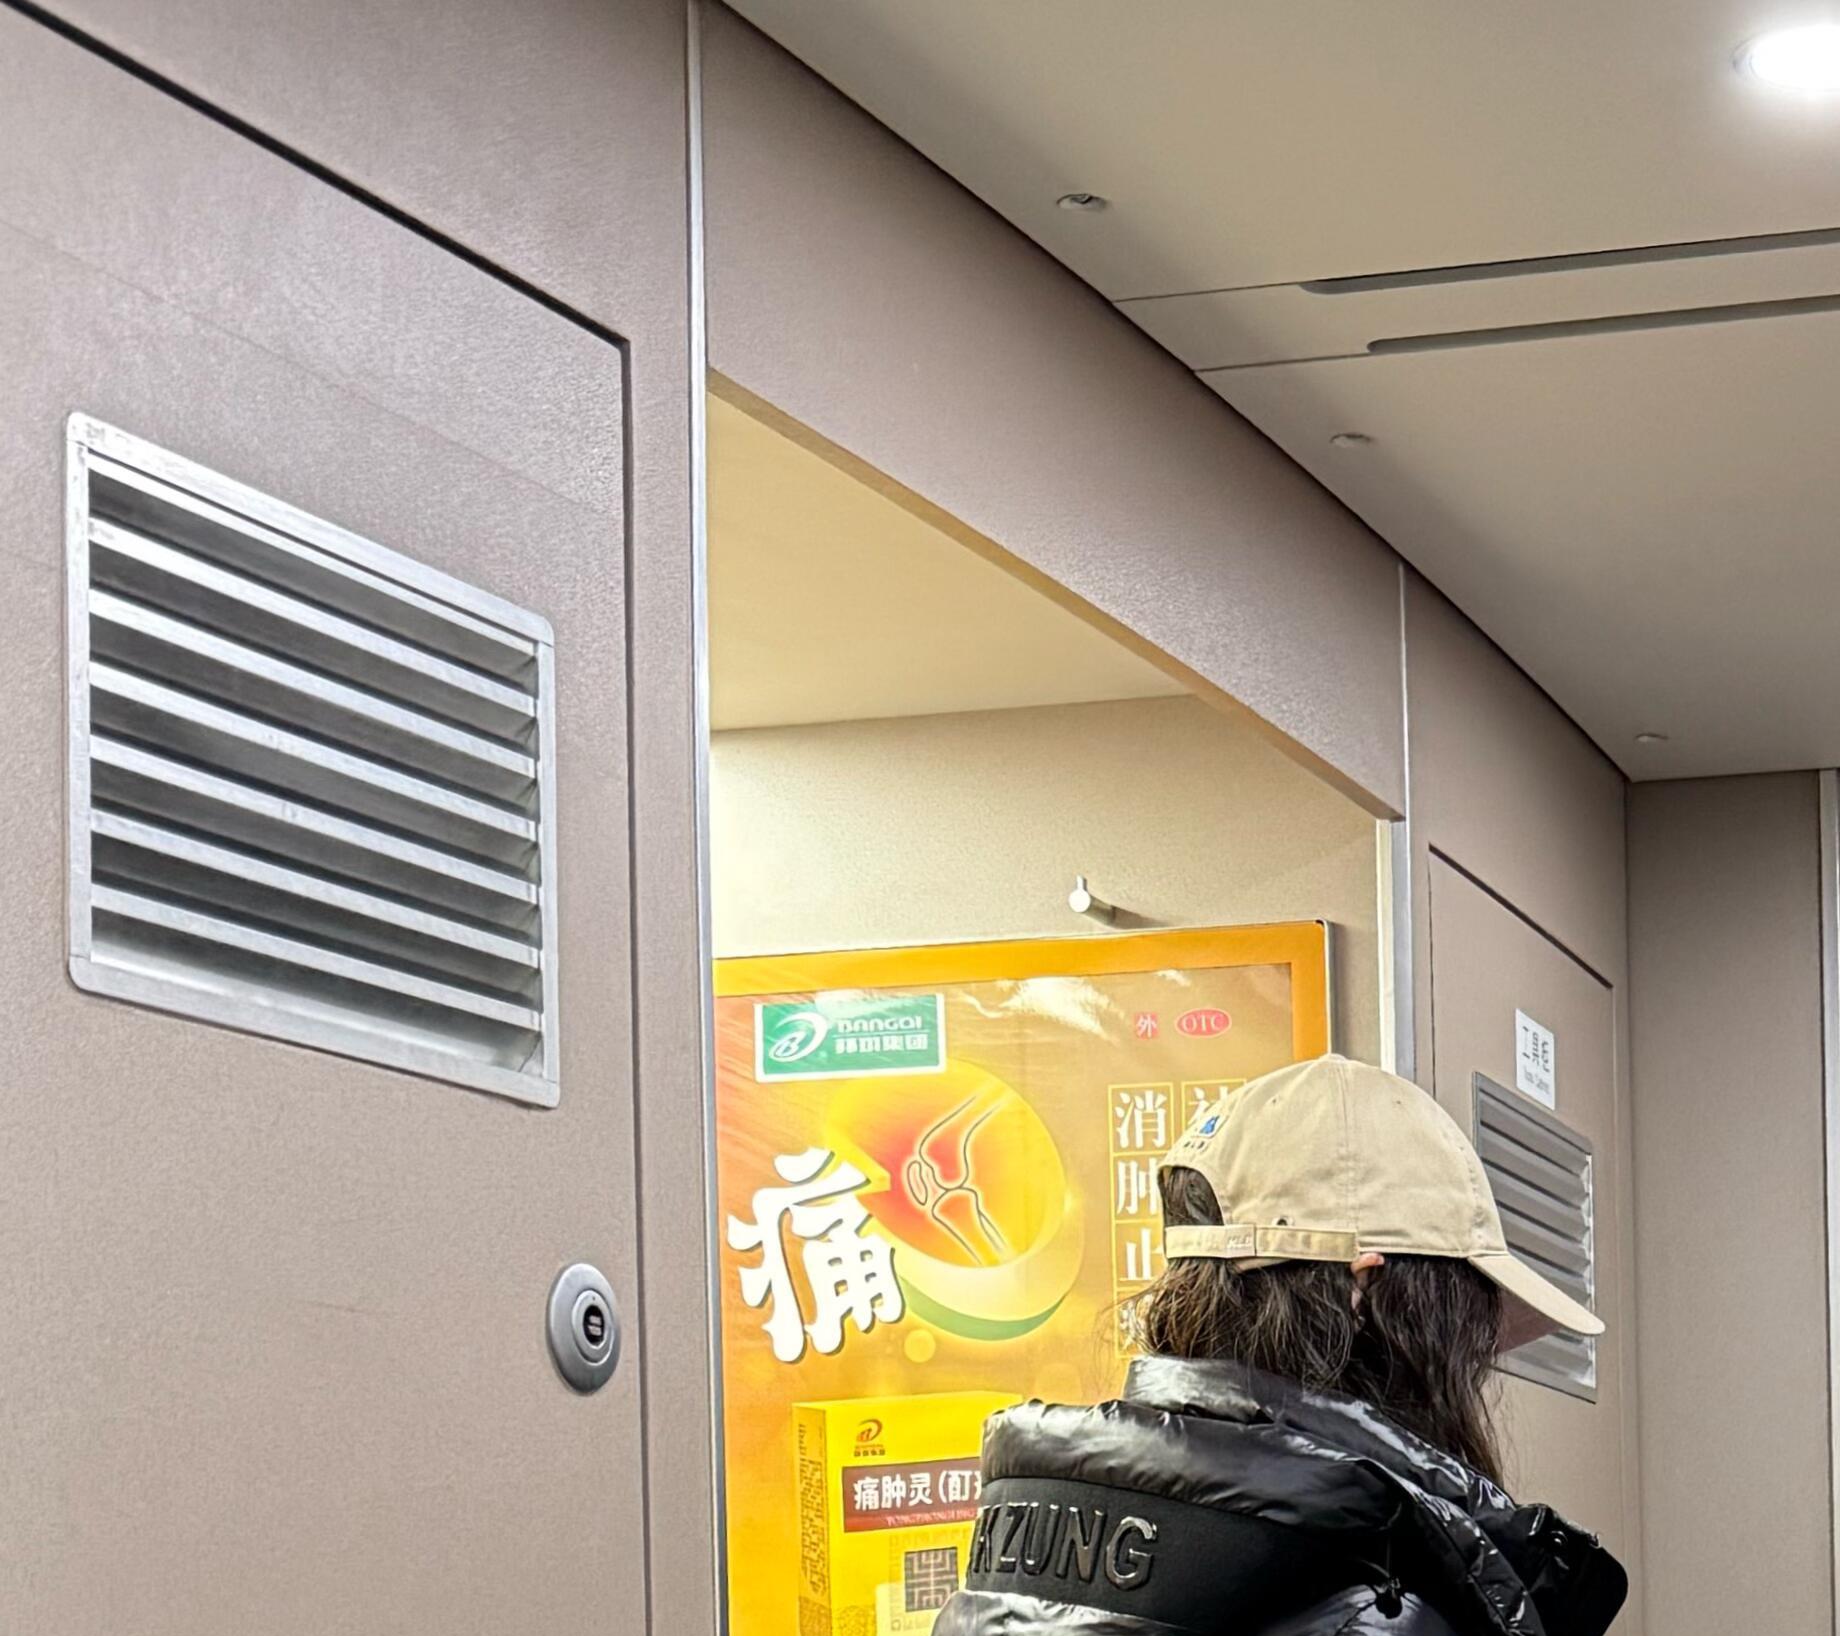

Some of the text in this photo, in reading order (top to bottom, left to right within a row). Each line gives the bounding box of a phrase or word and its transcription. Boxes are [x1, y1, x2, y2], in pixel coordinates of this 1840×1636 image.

[1136, 1014, 1157, 1038] 外
[1181, 1013, 1225, 1034] OTC
[726, 1146, 904, 1363] 痛
